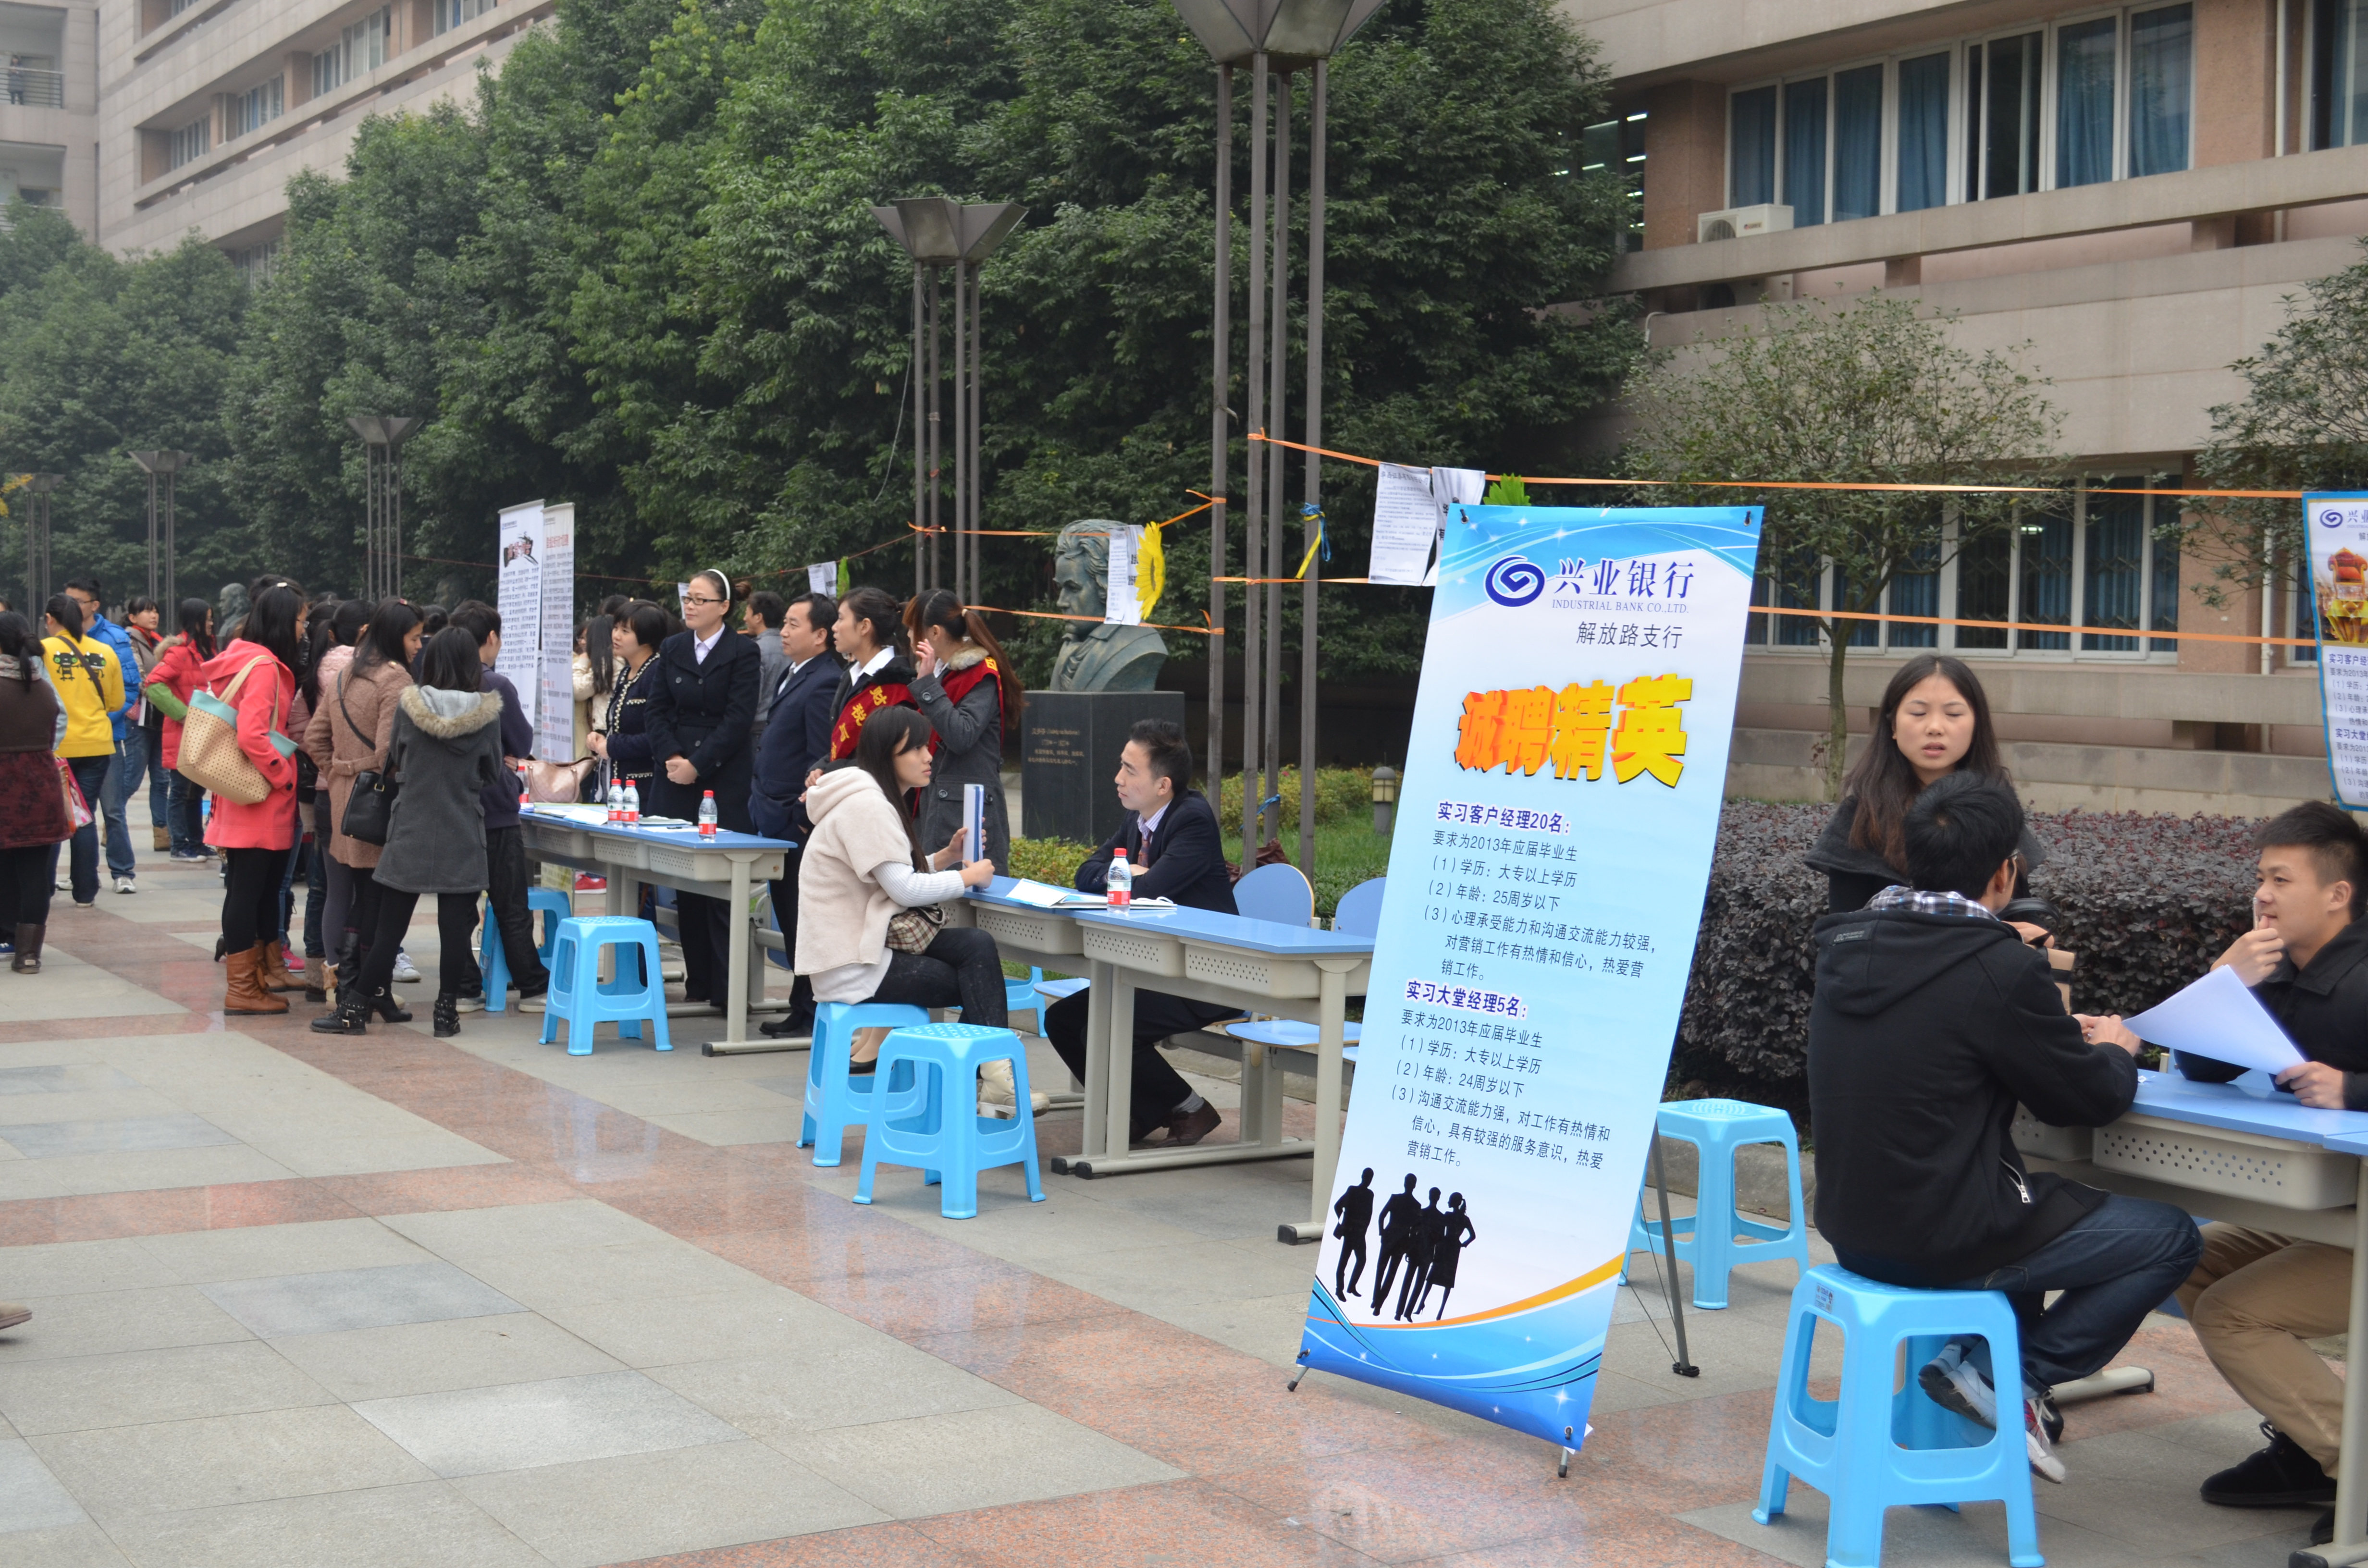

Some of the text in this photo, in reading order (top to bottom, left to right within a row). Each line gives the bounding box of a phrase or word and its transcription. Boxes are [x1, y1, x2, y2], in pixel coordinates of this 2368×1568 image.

[1554, 557, 1694, 600] 兴业银行
[1552, 599, 1690, 614] INDUSTRIAL BANK CO.,LTD.
[1576, 621, 1683, 649] 解放路支行
[2329, 654, 2368, 666] 实习客户经
[1455, 673, 1692, 788] 诚聘精英
[2335, 728, 2368, 740] 实习大堂
[1437, 801, 1570, 833] 实习客户经理20名：
[1433, 830, 1578, 861] 要求为2013年应届毕业生
[1442, 959, 1484, 980] 销工作。
[1445, 935, 1644, 978] 对营销工作有热情和信心，热爱营
[1406, 980, 1527, 1018] 实习大堂经理5名：
[1401, 1009, 1542, 1048] 要求为2013年应届毕业生
[1407, 1140, 1461, 1167] 营销工作。
[1412, 1115, 1603, 1170] 信心，具有较强的服务意识，热爱
